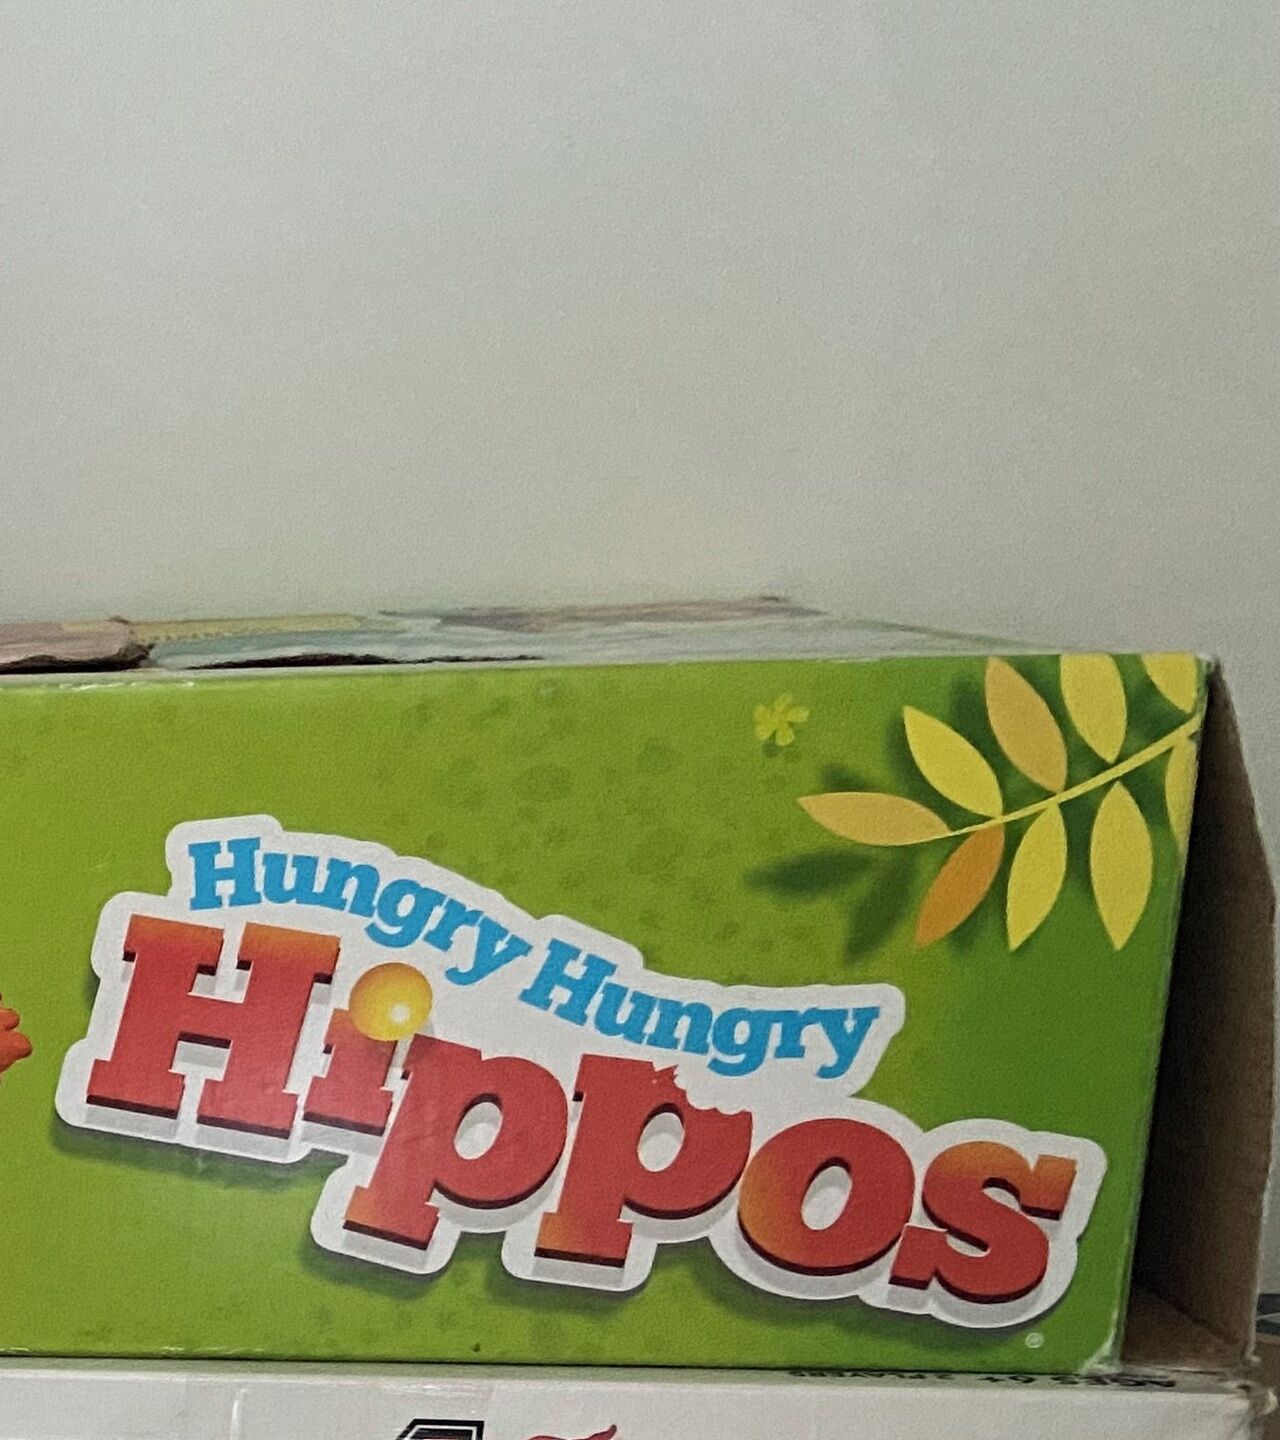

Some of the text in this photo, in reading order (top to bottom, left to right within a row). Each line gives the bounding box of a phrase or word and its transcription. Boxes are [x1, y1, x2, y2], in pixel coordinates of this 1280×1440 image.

[86, 914, 1078, 1304] Hippos
[187, 837, 882, 1080] Hungry Hungry
